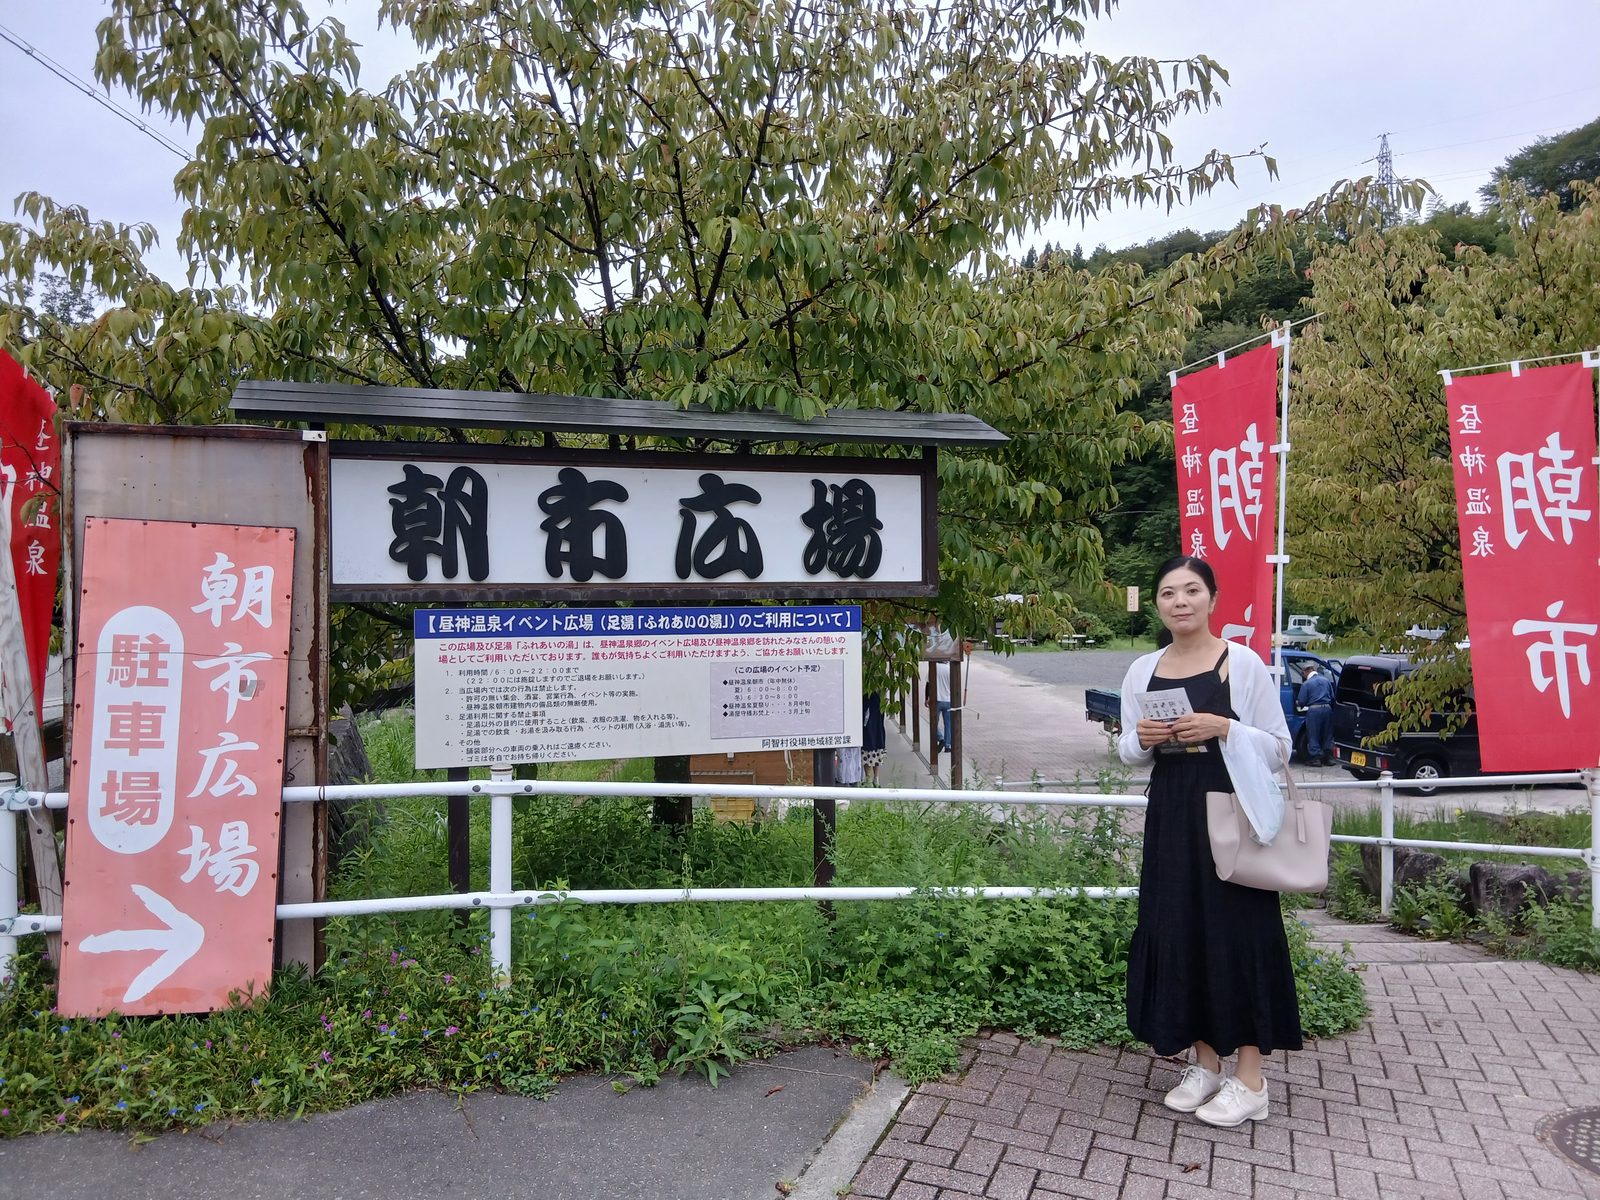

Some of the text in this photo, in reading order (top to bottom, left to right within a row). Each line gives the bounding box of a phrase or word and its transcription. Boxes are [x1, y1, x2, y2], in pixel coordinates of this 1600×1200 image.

[387, 463, 883, 582] 朝市広場
[99, 631, 172, 828] 駐車場
[177, 552, 275, 897] 朝市広場
